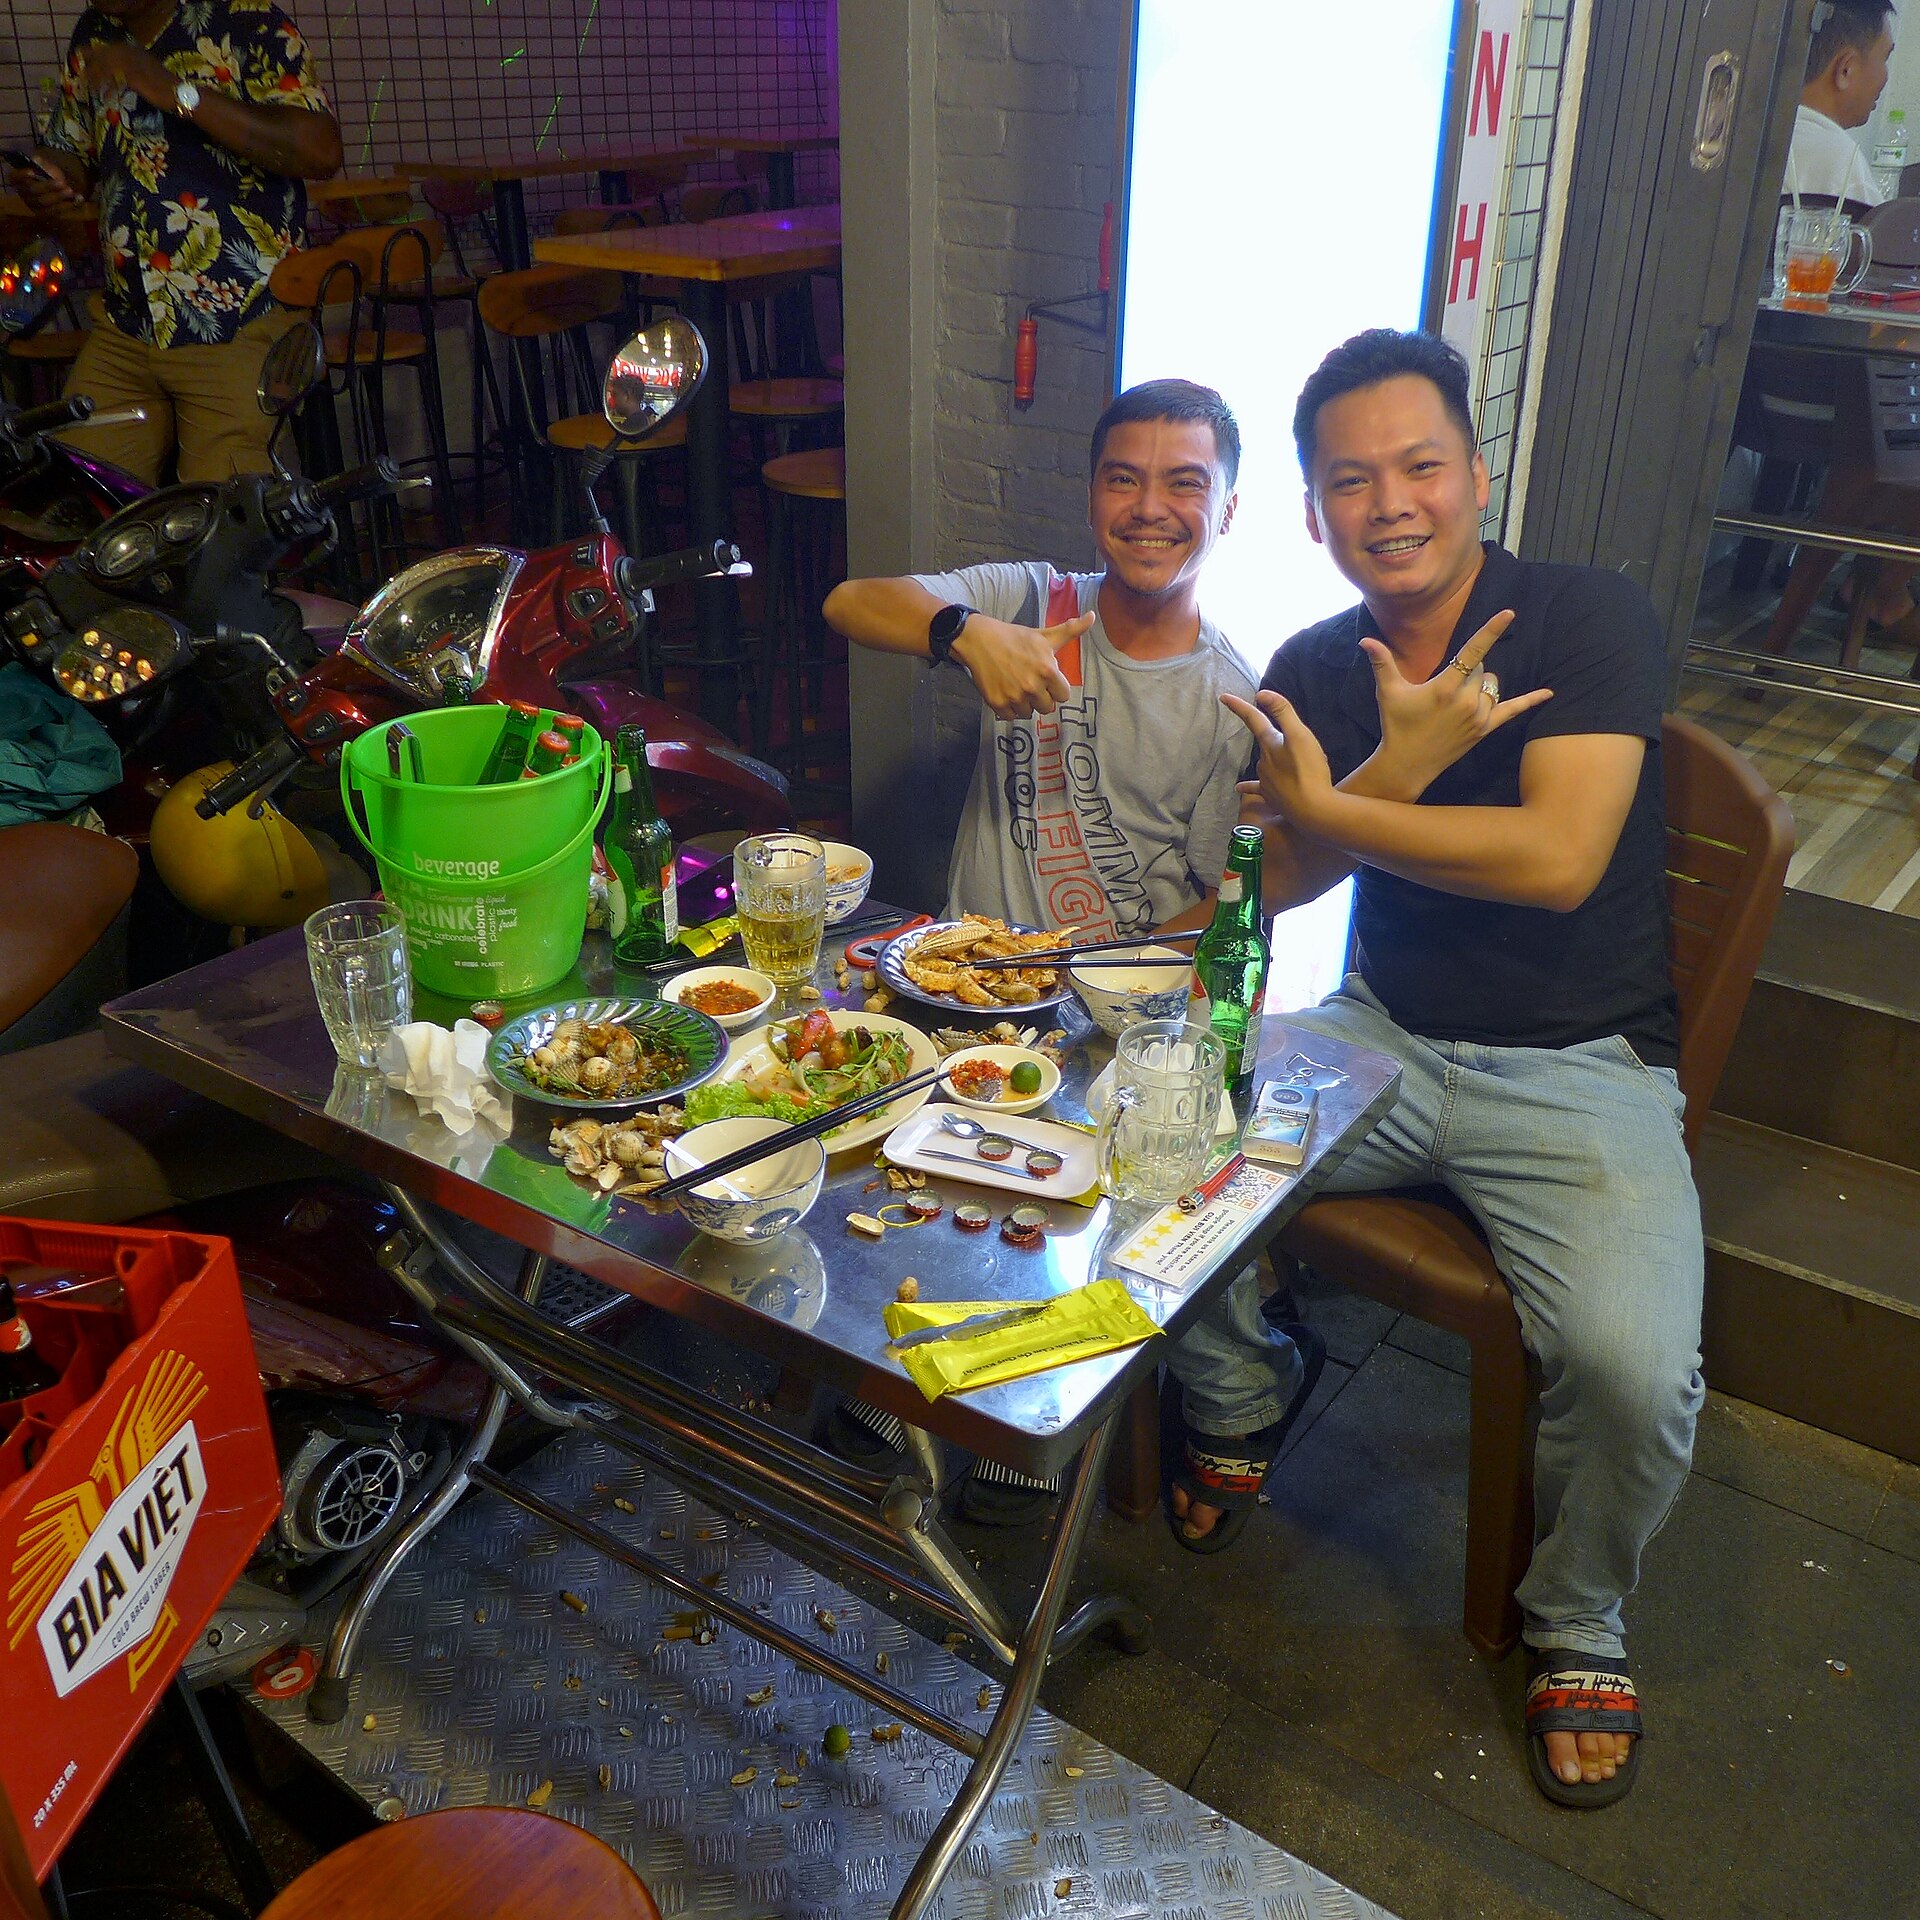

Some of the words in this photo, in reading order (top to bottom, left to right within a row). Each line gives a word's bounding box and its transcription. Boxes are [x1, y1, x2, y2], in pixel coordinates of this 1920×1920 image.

[994, 712, 1038, 851] 985
[1059, 696, 1161, 935] TOMMY
[412, 851, 500, 880] beverage
[401, 896, 476, 931] DRINK
[434, 932, 477, 943] carbonated
[475, 897, 487, 954] celebrate
[489, 908, 498, 942] plastic
[52, 1550, 128, 1673] BIA
[118, 1443, 194, 1574] VIỆT
[112, 1620, 130, 1649] COLD
[130, 1596, 149, 1621] BREW
[150, 1561, 171, 1595] LAGER
